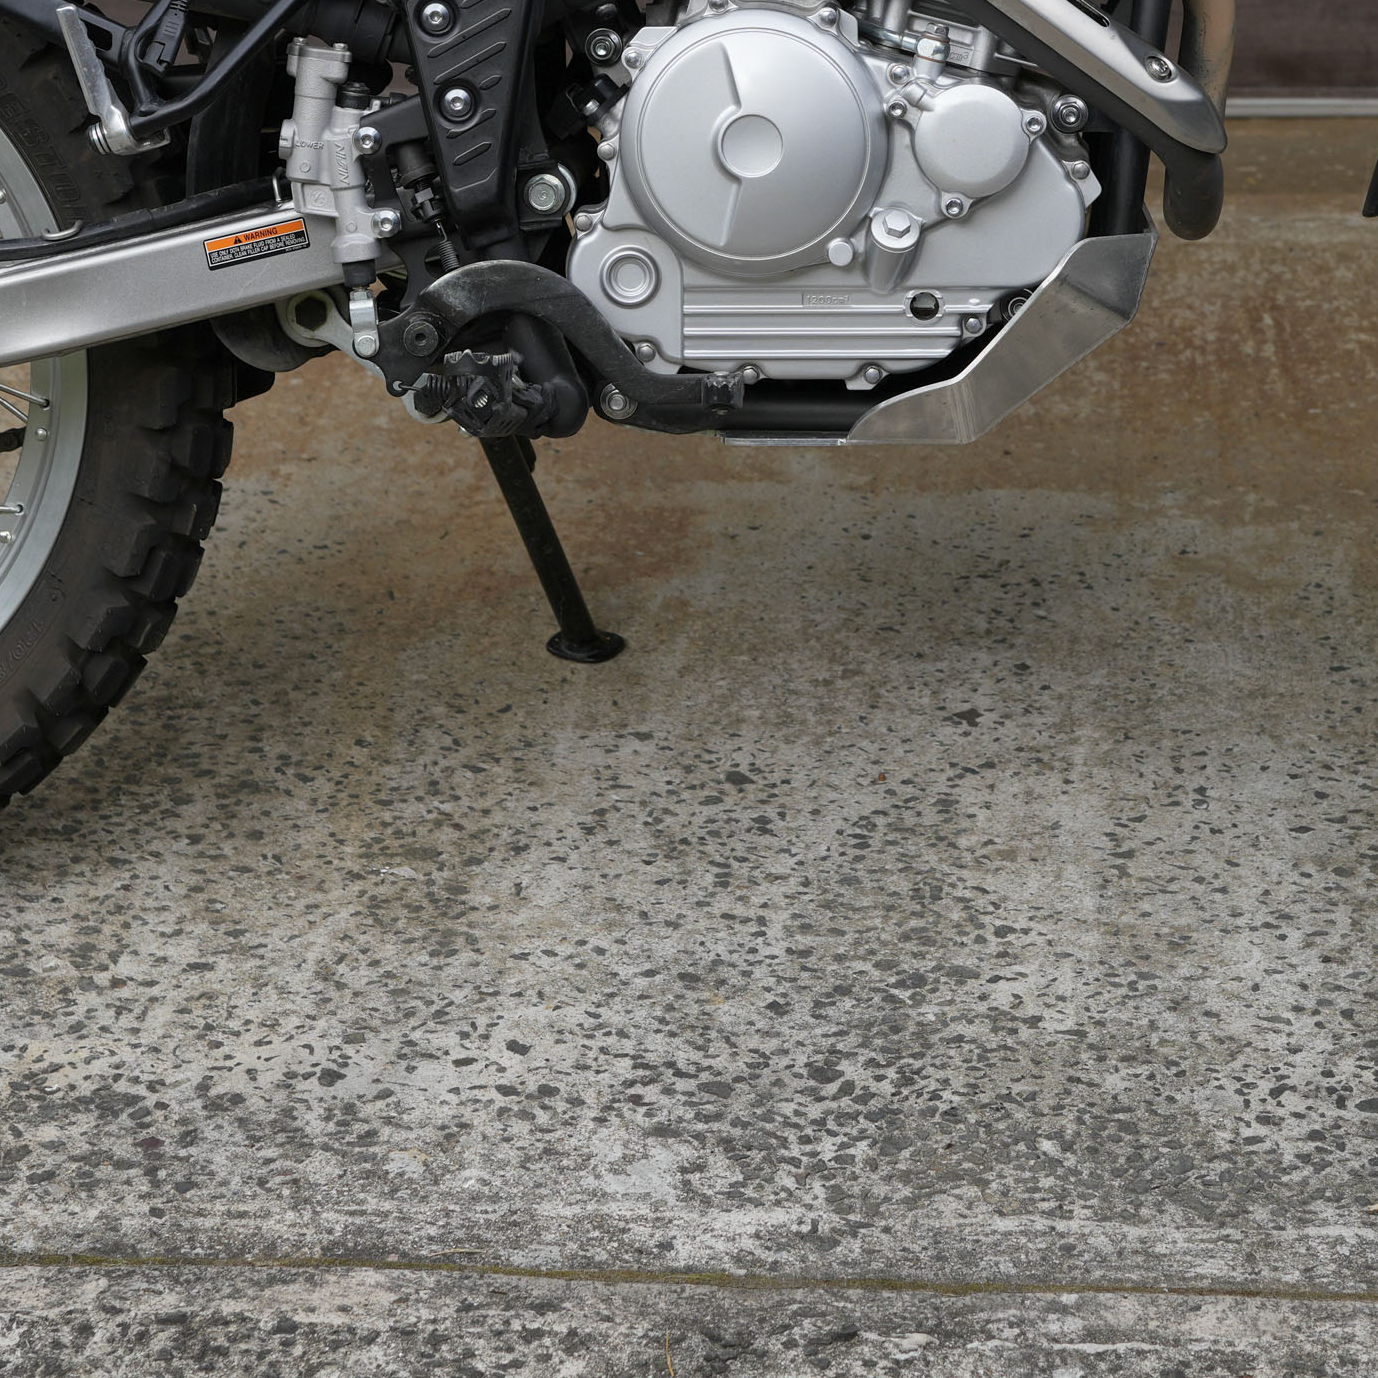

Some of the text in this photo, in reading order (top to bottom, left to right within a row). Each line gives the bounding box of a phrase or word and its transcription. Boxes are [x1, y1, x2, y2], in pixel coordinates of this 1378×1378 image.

[294, 141, 324, 150] LOWER
[243, 227, 278, 241] WARNING
[269, 241, 285, 249] BEFORE
